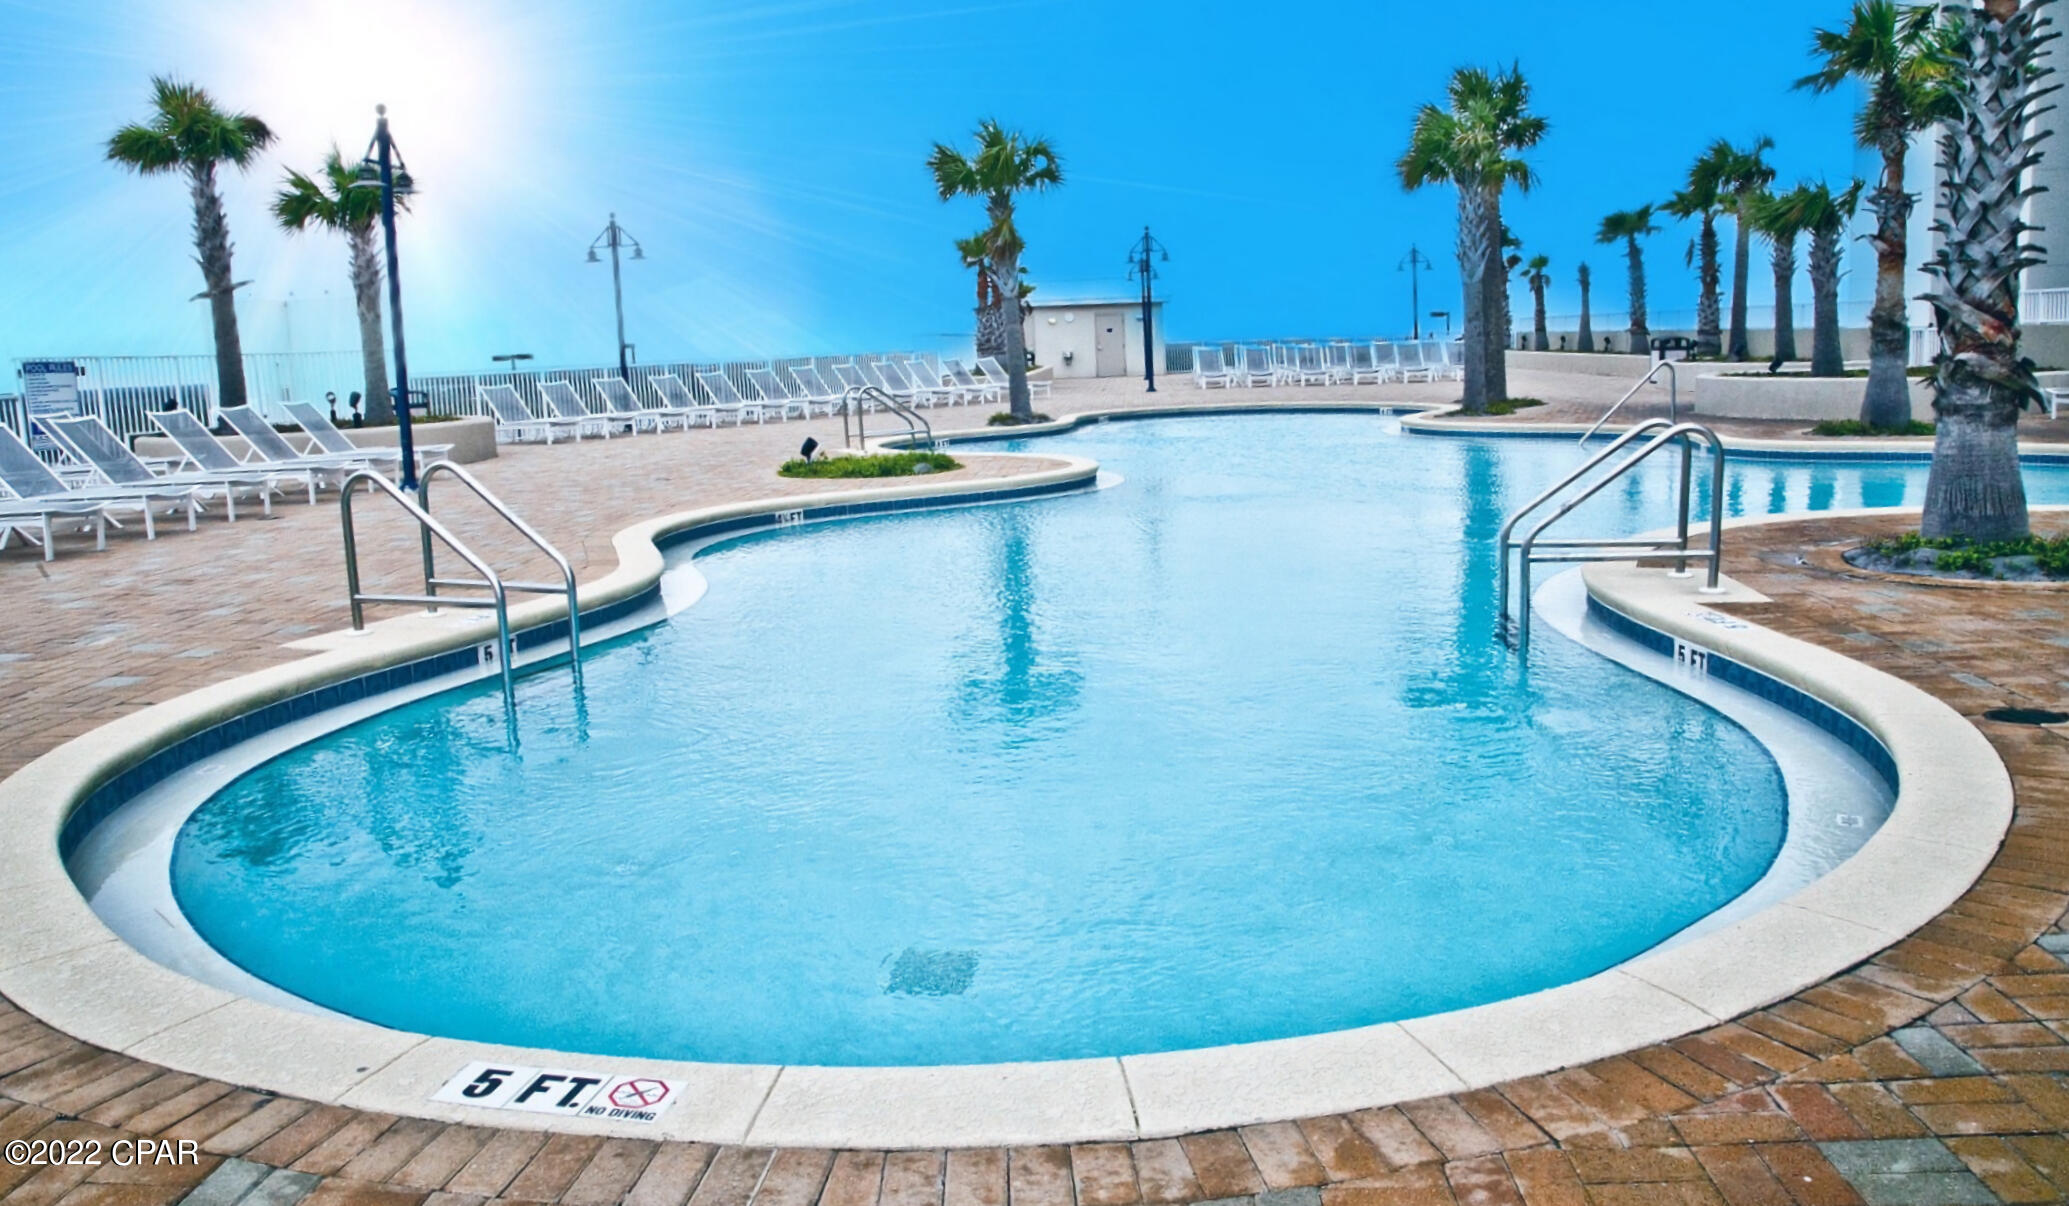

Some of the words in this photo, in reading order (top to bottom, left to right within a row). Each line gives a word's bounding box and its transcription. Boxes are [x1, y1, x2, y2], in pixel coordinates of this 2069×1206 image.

[484, 645, 493, 661] 5
[1678, 645, 1685, 662] 5
[1691, 648, 1705, 670] FT
[462, 1068, 514, 1098] 5
[514, 1073, 602, 1108] FT.
[584, 1105, 607, 1116] NO
[608, 1108, 657, 1121] DIVING
